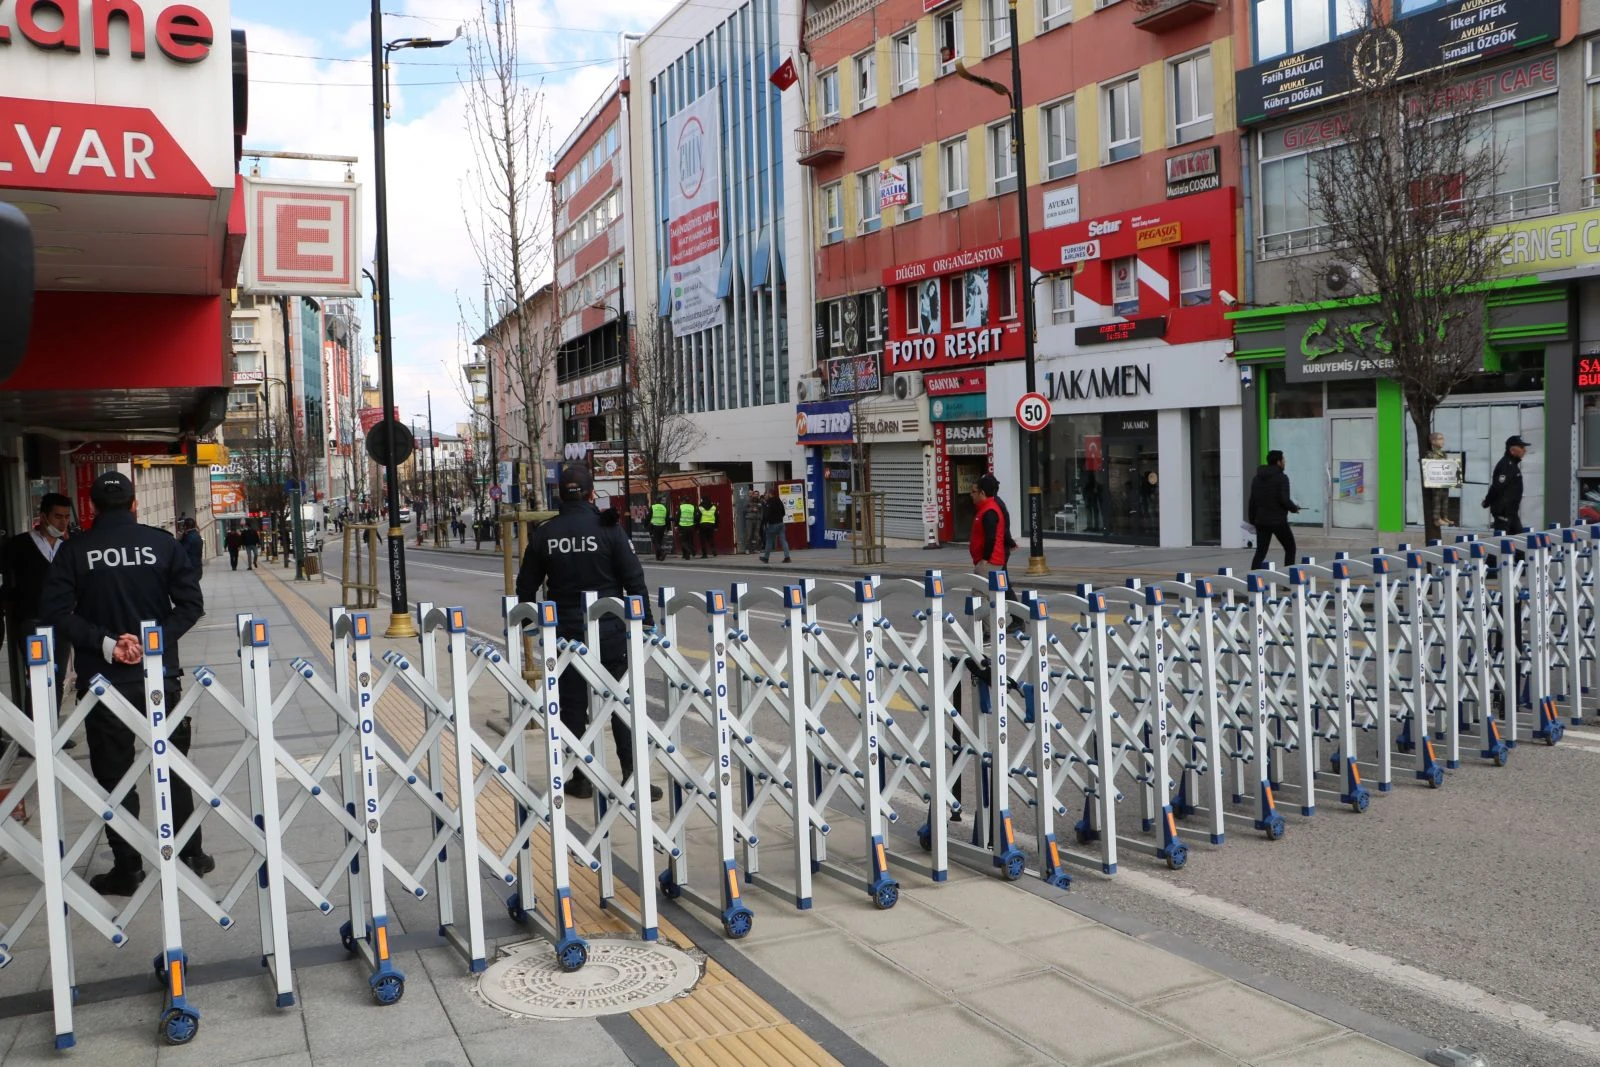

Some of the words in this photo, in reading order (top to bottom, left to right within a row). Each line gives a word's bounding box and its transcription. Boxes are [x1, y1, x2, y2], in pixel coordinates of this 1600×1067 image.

[1450, 14, 1477, 31] İlker
[1479, 3, 1507, 22] İPEK
[0, 0, 213, 63] ane
[1461, 22, 1495, 39] AVUKAT
[1477, 28, 1517, 49] ÖZGÖK
[1279, 54, 1305, 68] AVUKAT
[1262, 73, 1283, 86] Fatih
[1285, 59, 1323, 79] BAKLACI
[1499, 60, 1556, 95] CAFE
[1279, 79, 1306, 91] AVUKAT
[1264, 97, 1290, 109] Kübra
[1291, 86, 1323, 103] DOĞAN
[1048, 197, 1075, 210] AVUKAT
[276, 204, 334, 271] E
[1088, 219, 1122, 237] Setur
[1138, 225, 1178, 241] PEGASUS
[1583, 219, 1600, 254] C
[1064, 245, 1086, 255] TURKISH
[895, 263, 926, 281] DÜĞÜN
[933, 245, 1004, 273] ORGANİZASYON
[892, 337, 936, 366] FOTO
[944, 328, 1004, 361] REŞAT
[1303, 359, 1354, 374] KURUYEMİŞ
[929, 377, 961, 391] GANYAN
[1046, 363, 1151, 401] JAKAMEN
[807, 411, 851, 434] METRO
[1024, 404, 1043, 422] 50
[945, 427, 985, 442] BAŞAK
[1122, 420, 1150, 431] JAKAMEN
[806, 447, 815, 525] METRO
